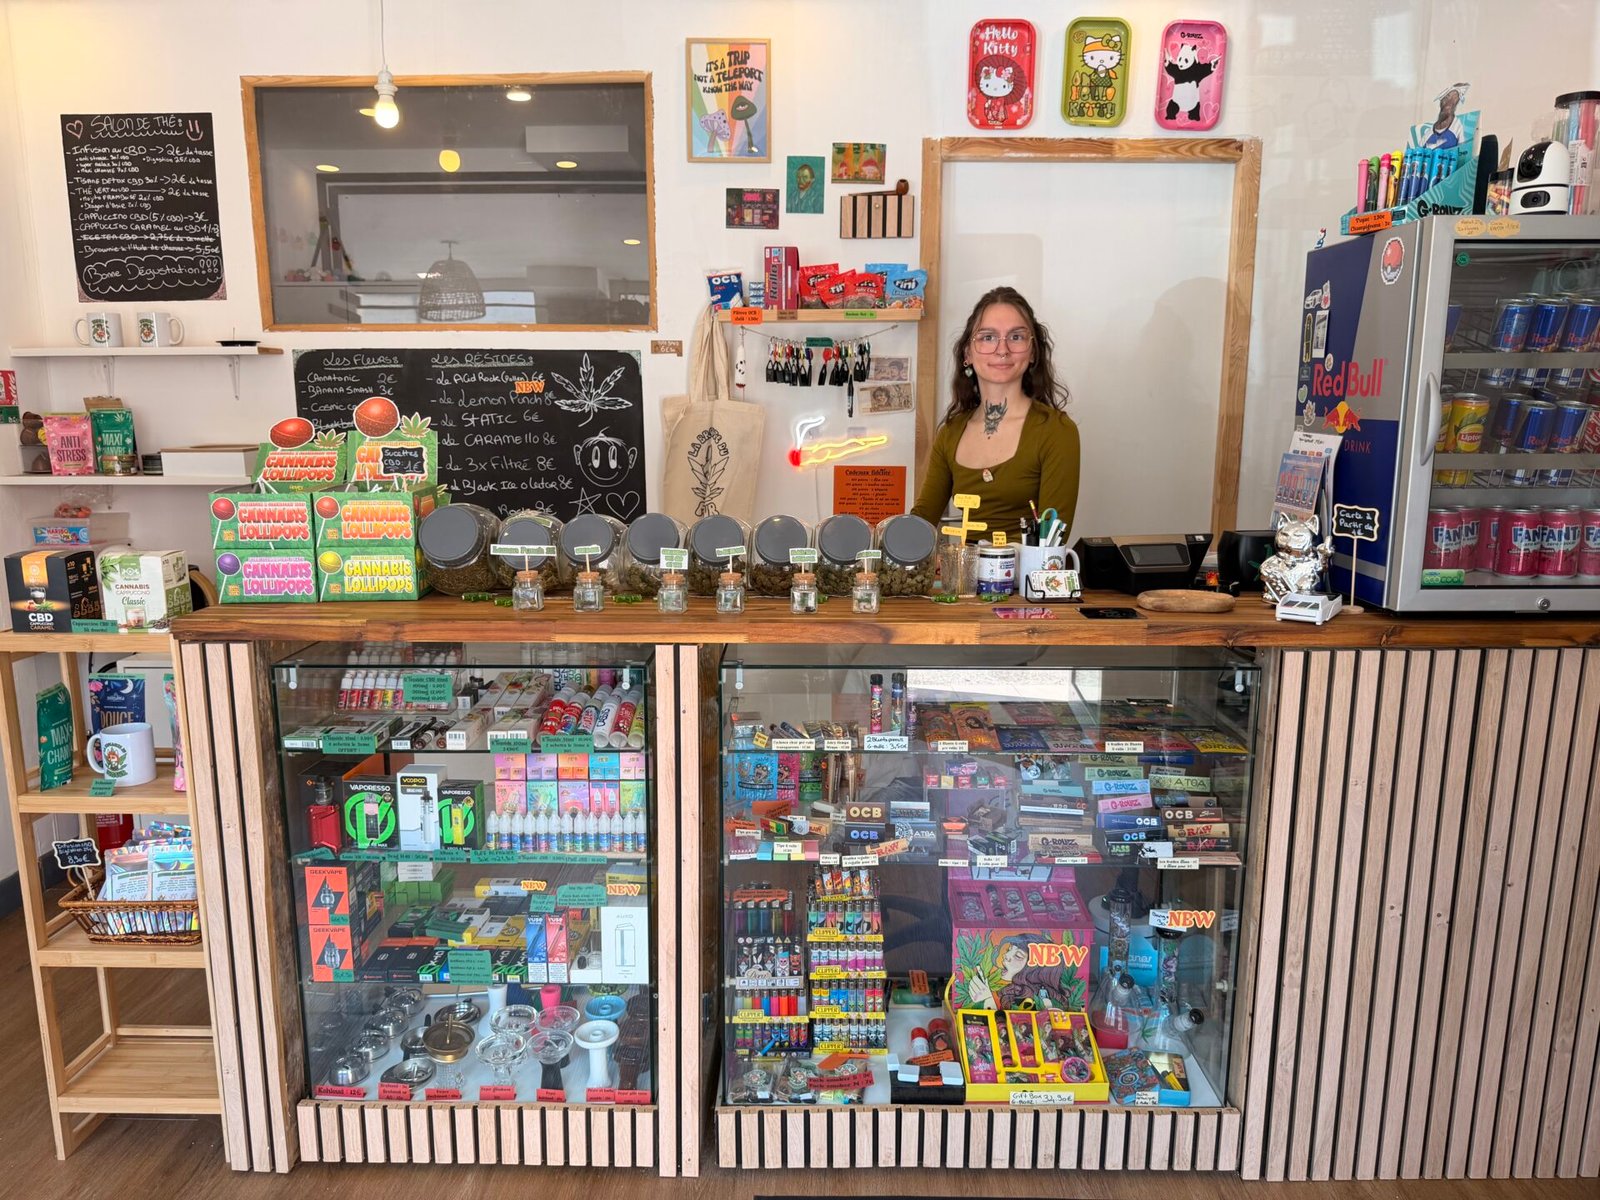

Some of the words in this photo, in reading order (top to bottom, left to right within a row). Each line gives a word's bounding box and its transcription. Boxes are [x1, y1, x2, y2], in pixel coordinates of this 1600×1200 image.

[984, 26, 1018, 41] Hello
[982, 41, 1018, 57] Kitty
[720, 58, 725, 70] A
[727, 50, 751, 67] TRIP
[694, 74, 708, 83] NOT
[709, 75, 715, 83] A
[715, 67, 764, 83] TELEPORT
[702, 85, 722, 94] KNOW
[724, 82, 737, 92] THE
[738, 81, 754, 91] WAY
[90, 115, 135, 132] SALON
[136, 117, 150, 131] DE
[123, 145, 147, 156] CBD
[127, 178, 144, 186] CBD
[75, 185, 92, 195] THÉ
[129, 213, 149, 222] CBD
[129, 224, 171, 232] CARAMEL
[184, 224, 202, 233] CBD
[87, 267, 122, 285] Bonne
[711, 276, 739, 285] OCB
[377, 373, 398, 385] 2€
[478, 371, 501, 382] Rock
[1311, 360, 1346, 397] Red
[1346, 358, 1385, 398] Bull
[379, 385, 394, 396] 3€
[514, 380, 545, 394] NEW
[458, 388, 507, 408] Lemon
[509, 390, 543, 406] Punch
[523, 411, 545, 423] 6€
[60, 436, 81, 448] ANTI
[102, 433, 123, 446] MAXI
[542, 431, 558, 445] 8€
[1344, 439, 1372, 454] DRINK
[56, 449, 87, 463] STRESS
[265, 455, 338, 468] CANNABIS
[404, 461, 423, 473] 1€
[536, 455, 557, 471] 8€
[262, 467, 336, 482] LOLLIPOPS
[462, 479, 499, 496] Black
[238, 507, 308, 523] CANNABIS
[341, 505, 411, 522] CANNABIS
[1339, 510, 1364, 519] Carte
[1365, 510, 1373, 521] à
[1339, 519, 1362, 529] Partir
[238, 524, 310, 541] LOLLIPOPS
[341, 523, 413, 539] LOLLIPOPS
[243, 562, 313, 579] CANNABIS
[344, 560, 413, 577] CANNABIS
[243, 579, 314, 596] LOLLIPOPS
[344, 577, 414, 594] LOLLIPOPS
[121, 596, 146, 606] Classic
[28, 613, 54, 623] CBD
[349, 783, 391, 792] VAPORESSO
[849, 806, 882, 818] OCB
[1164, 810, 1194, 820] OCB
[1135, 817, 1158, 826] OCB
[850, 829, 879, 840] OCB
[1123, 832, 1147, 841] OCB
[1186, 825, 1213, 836] RAW
[875, 840, 899, 857] RAW
[521, 881, 547, 891] NEW
[607, 884, 640, 896] NEW
[1168, 910, 1216, 928] NEW
[1028, 943, 1088, 967] NEW
[816, 967, 840, 975] CLIPPER
[816, 1006, 840, 1014] CLIPPER
